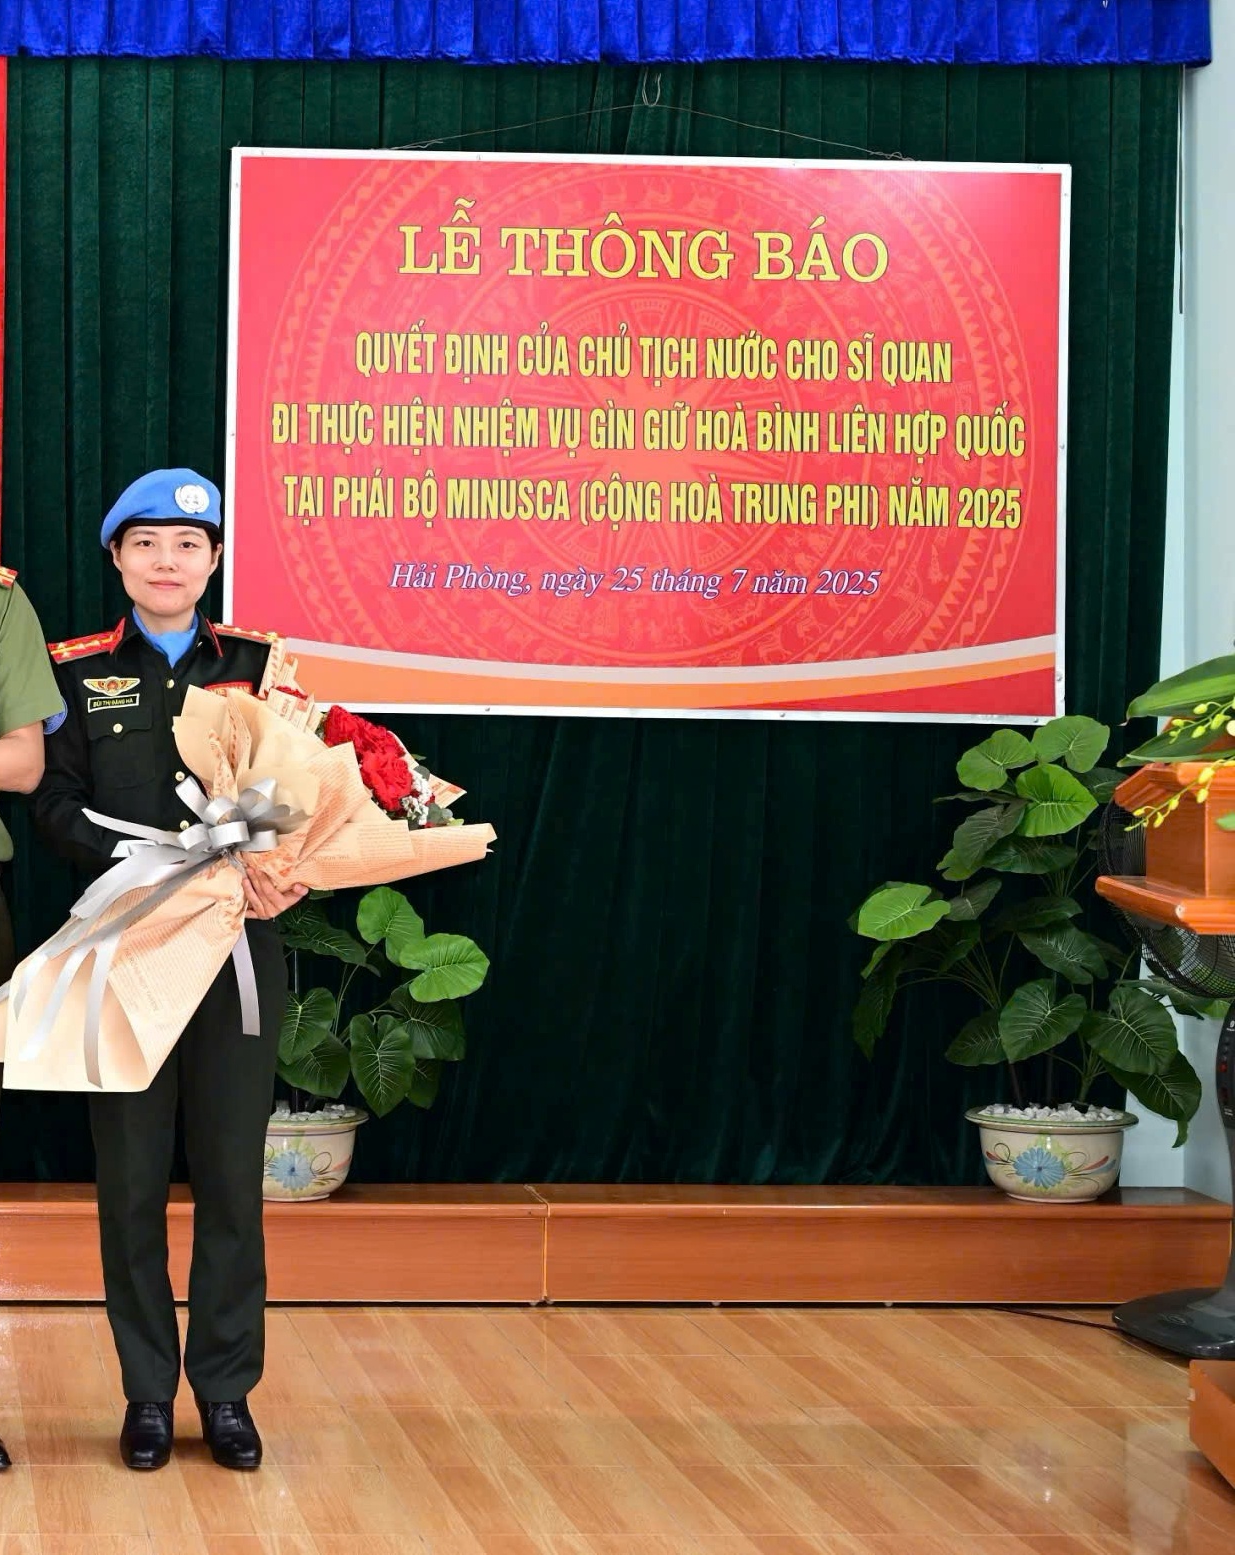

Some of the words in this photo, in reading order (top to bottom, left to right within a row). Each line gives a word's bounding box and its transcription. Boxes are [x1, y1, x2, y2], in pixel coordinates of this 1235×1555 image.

[399, 197, 480, 275] LỄ
[500, 212, 734, 280] THÔNG
[753, 216, 888, 283] BÁO
[356, 319, 437, 377] QUYẾT
[444, 333, 509, 384] ĐỊNH
[517, 322, 570, 377] CỦA
[578, 323, 631, 378] CHỦ
[639, 337, 697, 387] TỊCH
[706, 330, 778, 380] NƯỚC
[786, 339, 838, 381] CHO
[847, 332, 874, 381] SĨ
[881, 341, 951, 385] QUAN
[272, 403, 298, 444] ĐI
[306, 400, 374, 454] THỰC
[383, 397, 444, 455] HIỆN
[453, 398, 539, 457] NHIỆM
[547, 407, 581, 457] VỤ
[589, 400, 635, 450] GÌN
[643, 401, 691, 451] GIỮ
[696, 402, 748, 452] HOÀ
[757, 402, 819, 452] BÌNH
[828, 404, 886, 454] LIÊN
[894, 409, 947, 464] HỢP
[955, 400, 1025, 460] QUỐC
[283, 475, 324, 526] TẠI
[333, 469, 394, 518] PHÁI
[403, 469, 438, 527] BỘ
[447, 478, 570, 520] MINUSCA
[580, 472, 661, 532] (CỘNG
[670, 473, 723, 523] HOÀ
[730, 483, 817, 525] TRUNG
[825, 484, 880, 531] PHI)
[888, 477, 949, 527] NĂM
[957, 487, 1021, 529] 2025
[390, 563, 437, 589] Hải
[443, 564, 531, 596] Phòng,
[540, 566, 603, 597] ngày
[611, 567, 645, 591] 25
[651, 568, 722, 598] tháng
[732, 569, 748, 592] 7
[753, 569, 807, 594] năm
[815, 570, 881, 594] 2025
